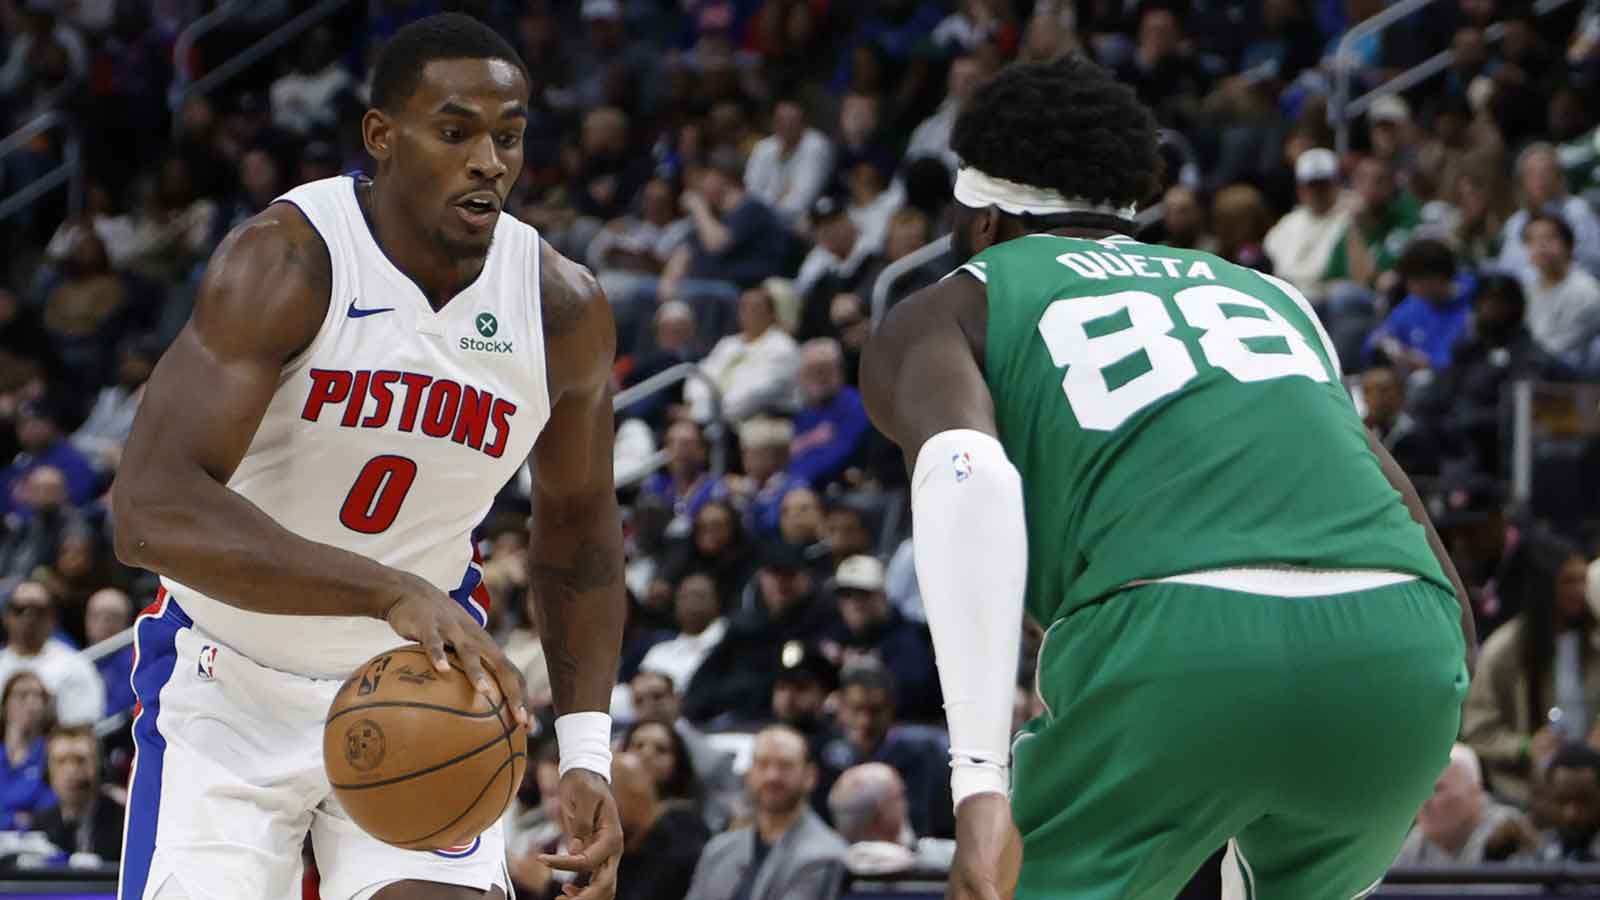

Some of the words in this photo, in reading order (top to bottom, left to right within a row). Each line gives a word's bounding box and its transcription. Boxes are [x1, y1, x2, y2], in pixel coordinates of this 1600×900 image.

[1055, 252, 1217, 280] QUETA
[459, 337, 513, 353] StockX
[1038, 285, 1330, 431] 88
[301, 368, 517, 458] PISTONS
[339, 455, 417, 534] 0
